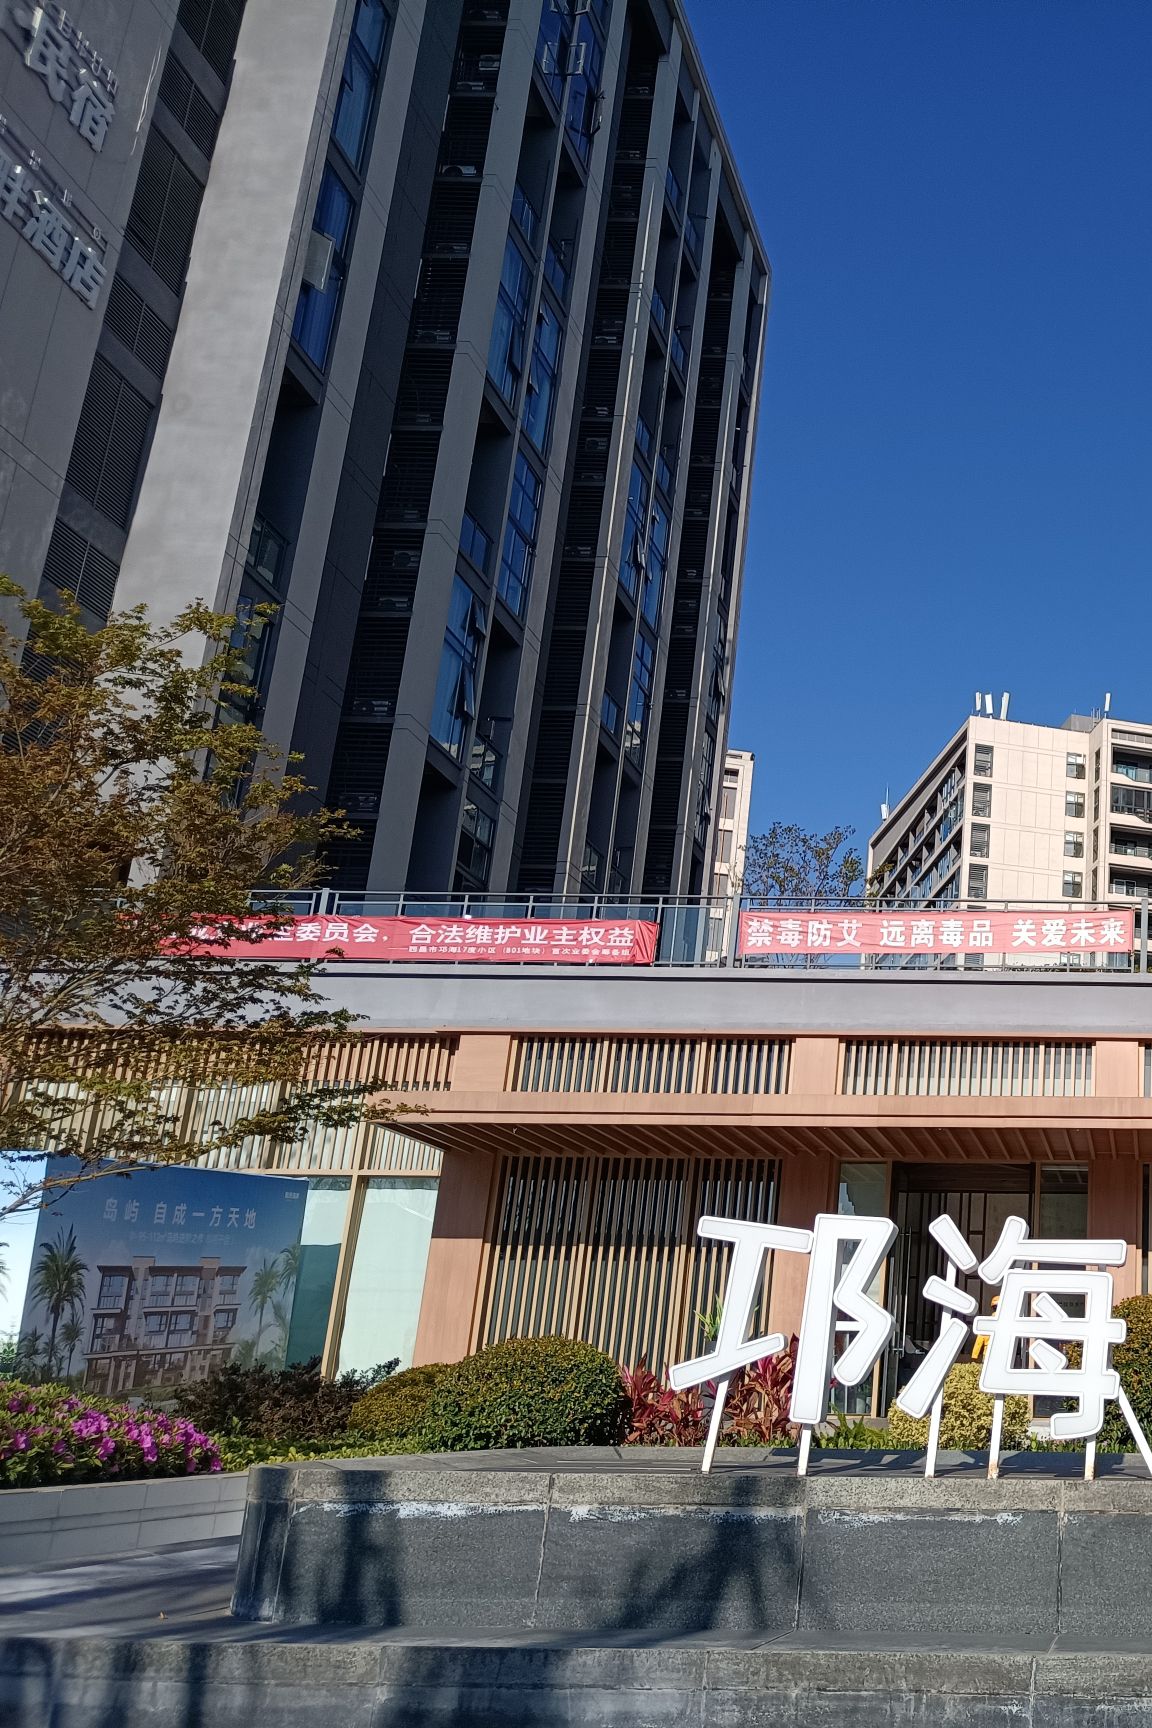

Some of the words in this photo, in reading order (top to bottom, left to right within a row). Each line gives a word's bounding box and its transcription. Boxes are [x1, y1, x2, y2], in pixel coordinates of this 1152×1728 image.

[747, 918, 862, 948] 禁毒防艾
[879, 919, 993, 947] 远离毒品
[1011, 919, 1126, 946] 关爱未来
[103, 1197, 139, 1222] 岛屿
[154, 1201, 257, 1229] 自成一方天地
